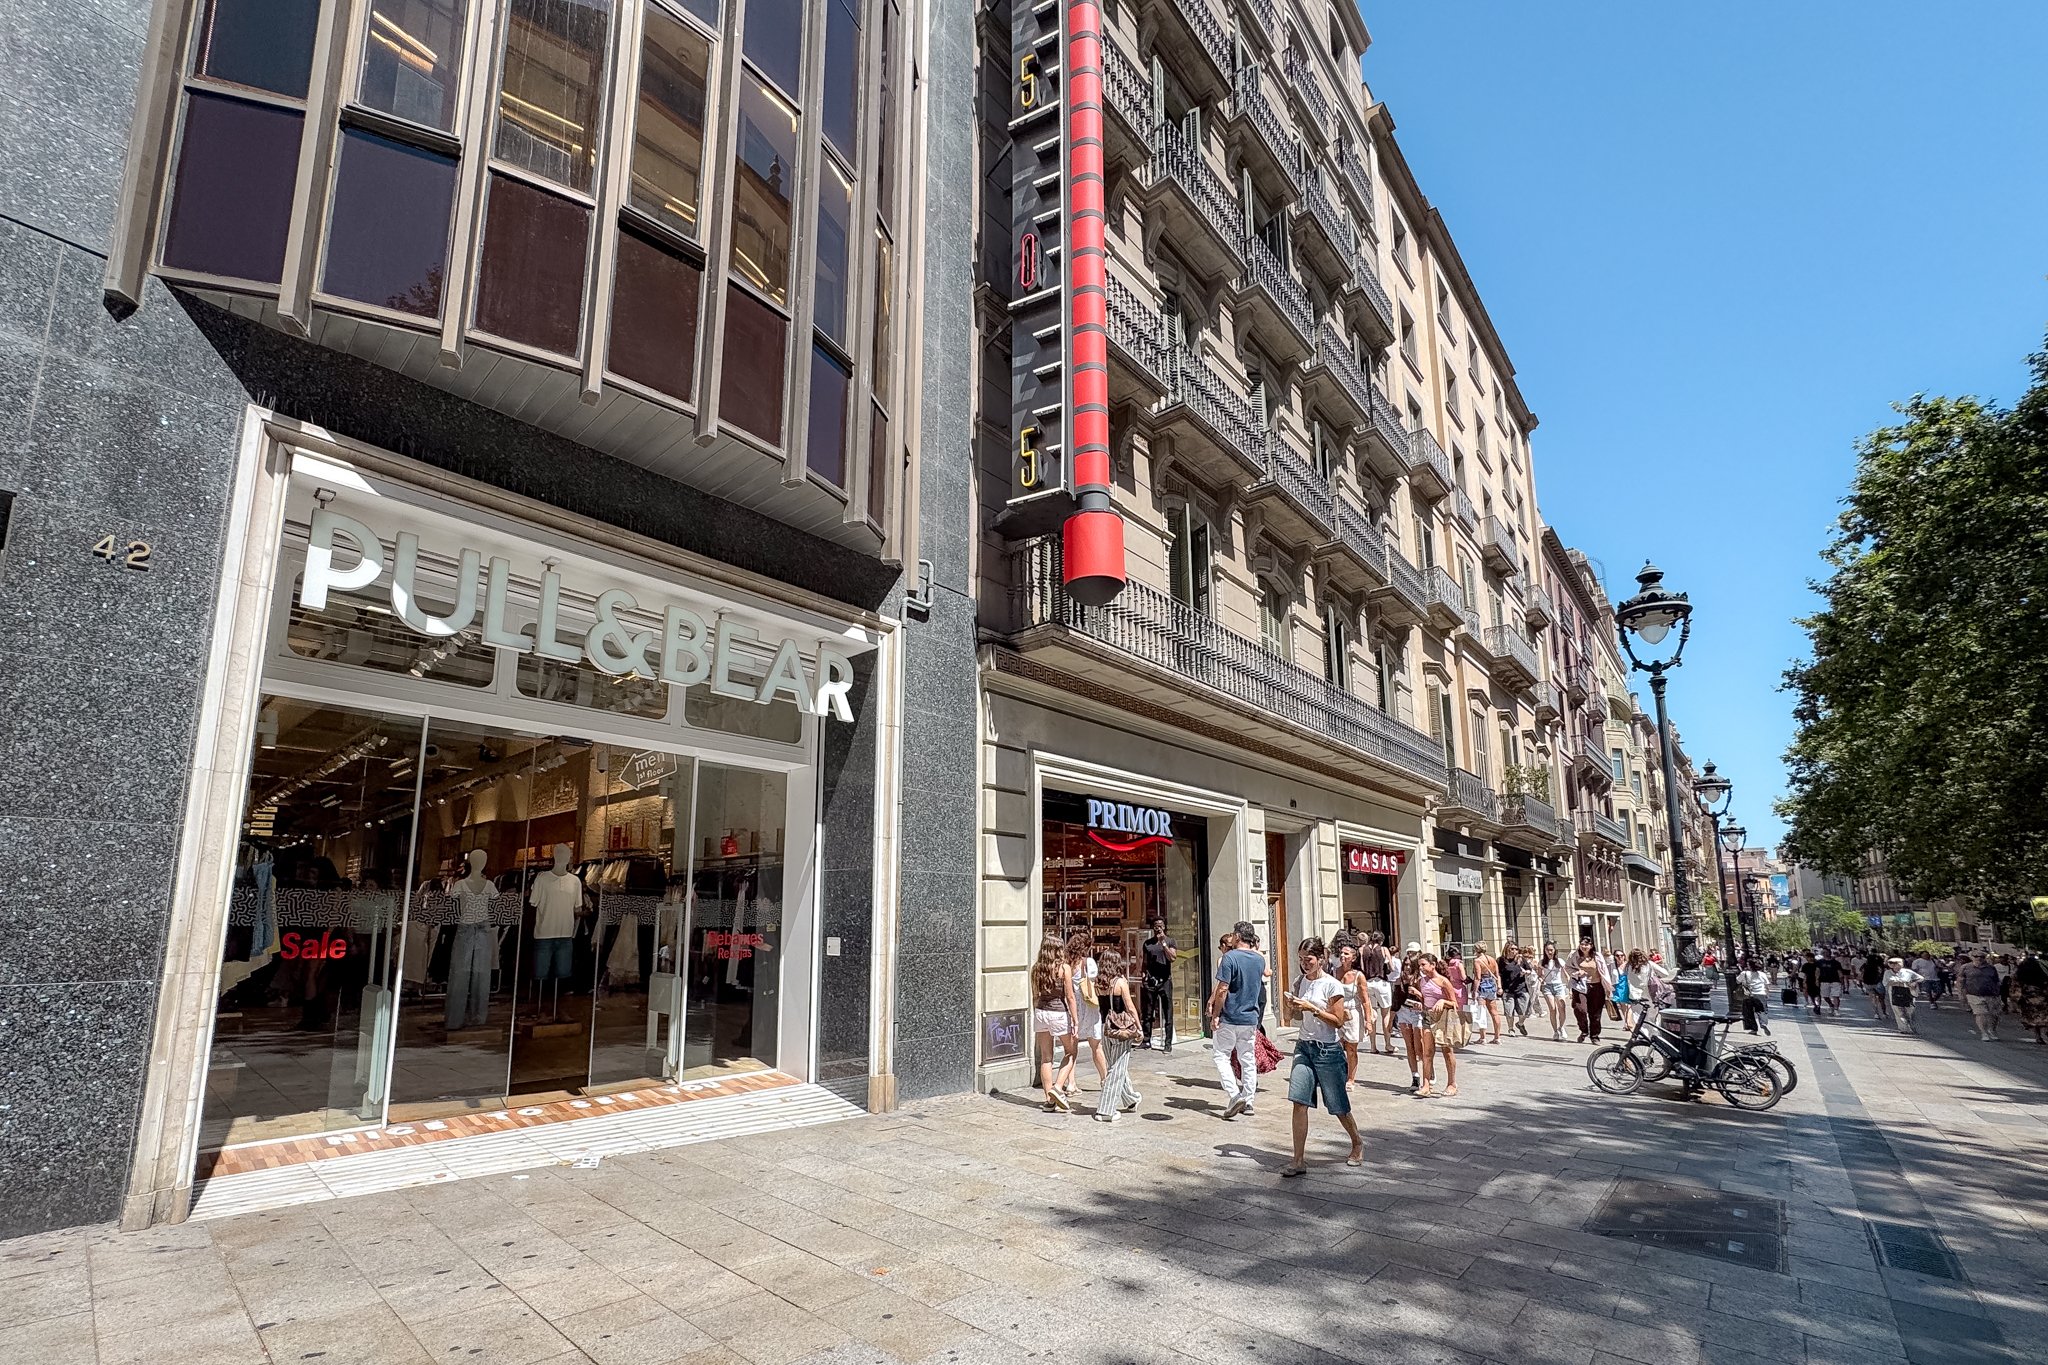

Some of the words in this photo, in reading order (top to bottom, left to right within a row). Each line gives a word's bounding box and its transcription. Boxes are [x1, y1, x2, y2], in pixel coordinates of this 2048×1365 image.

[1021, 53, 1035, 107] 5
[1021, 233, 1035, 287] 0
[1021, 427, 1036, 487] 5
[92, 534, 152, 572] 42
[299, 506, 854, 723] PULL&BEAR
[635, 752, 666, 772] men
[646, 767, 664, 779] floor
[1086, 798, 1174, 838] PRIMOR
[1350, 848, 1398, 872] CASAS
[280, 931, 347, 960] Sale
[325, 1119, 448, 1145] NICE
[485, 1106, 543, 1121] TO
[570, 1092, 638, 1109] SEE
[660, 1080, 721, 1095] YOU
